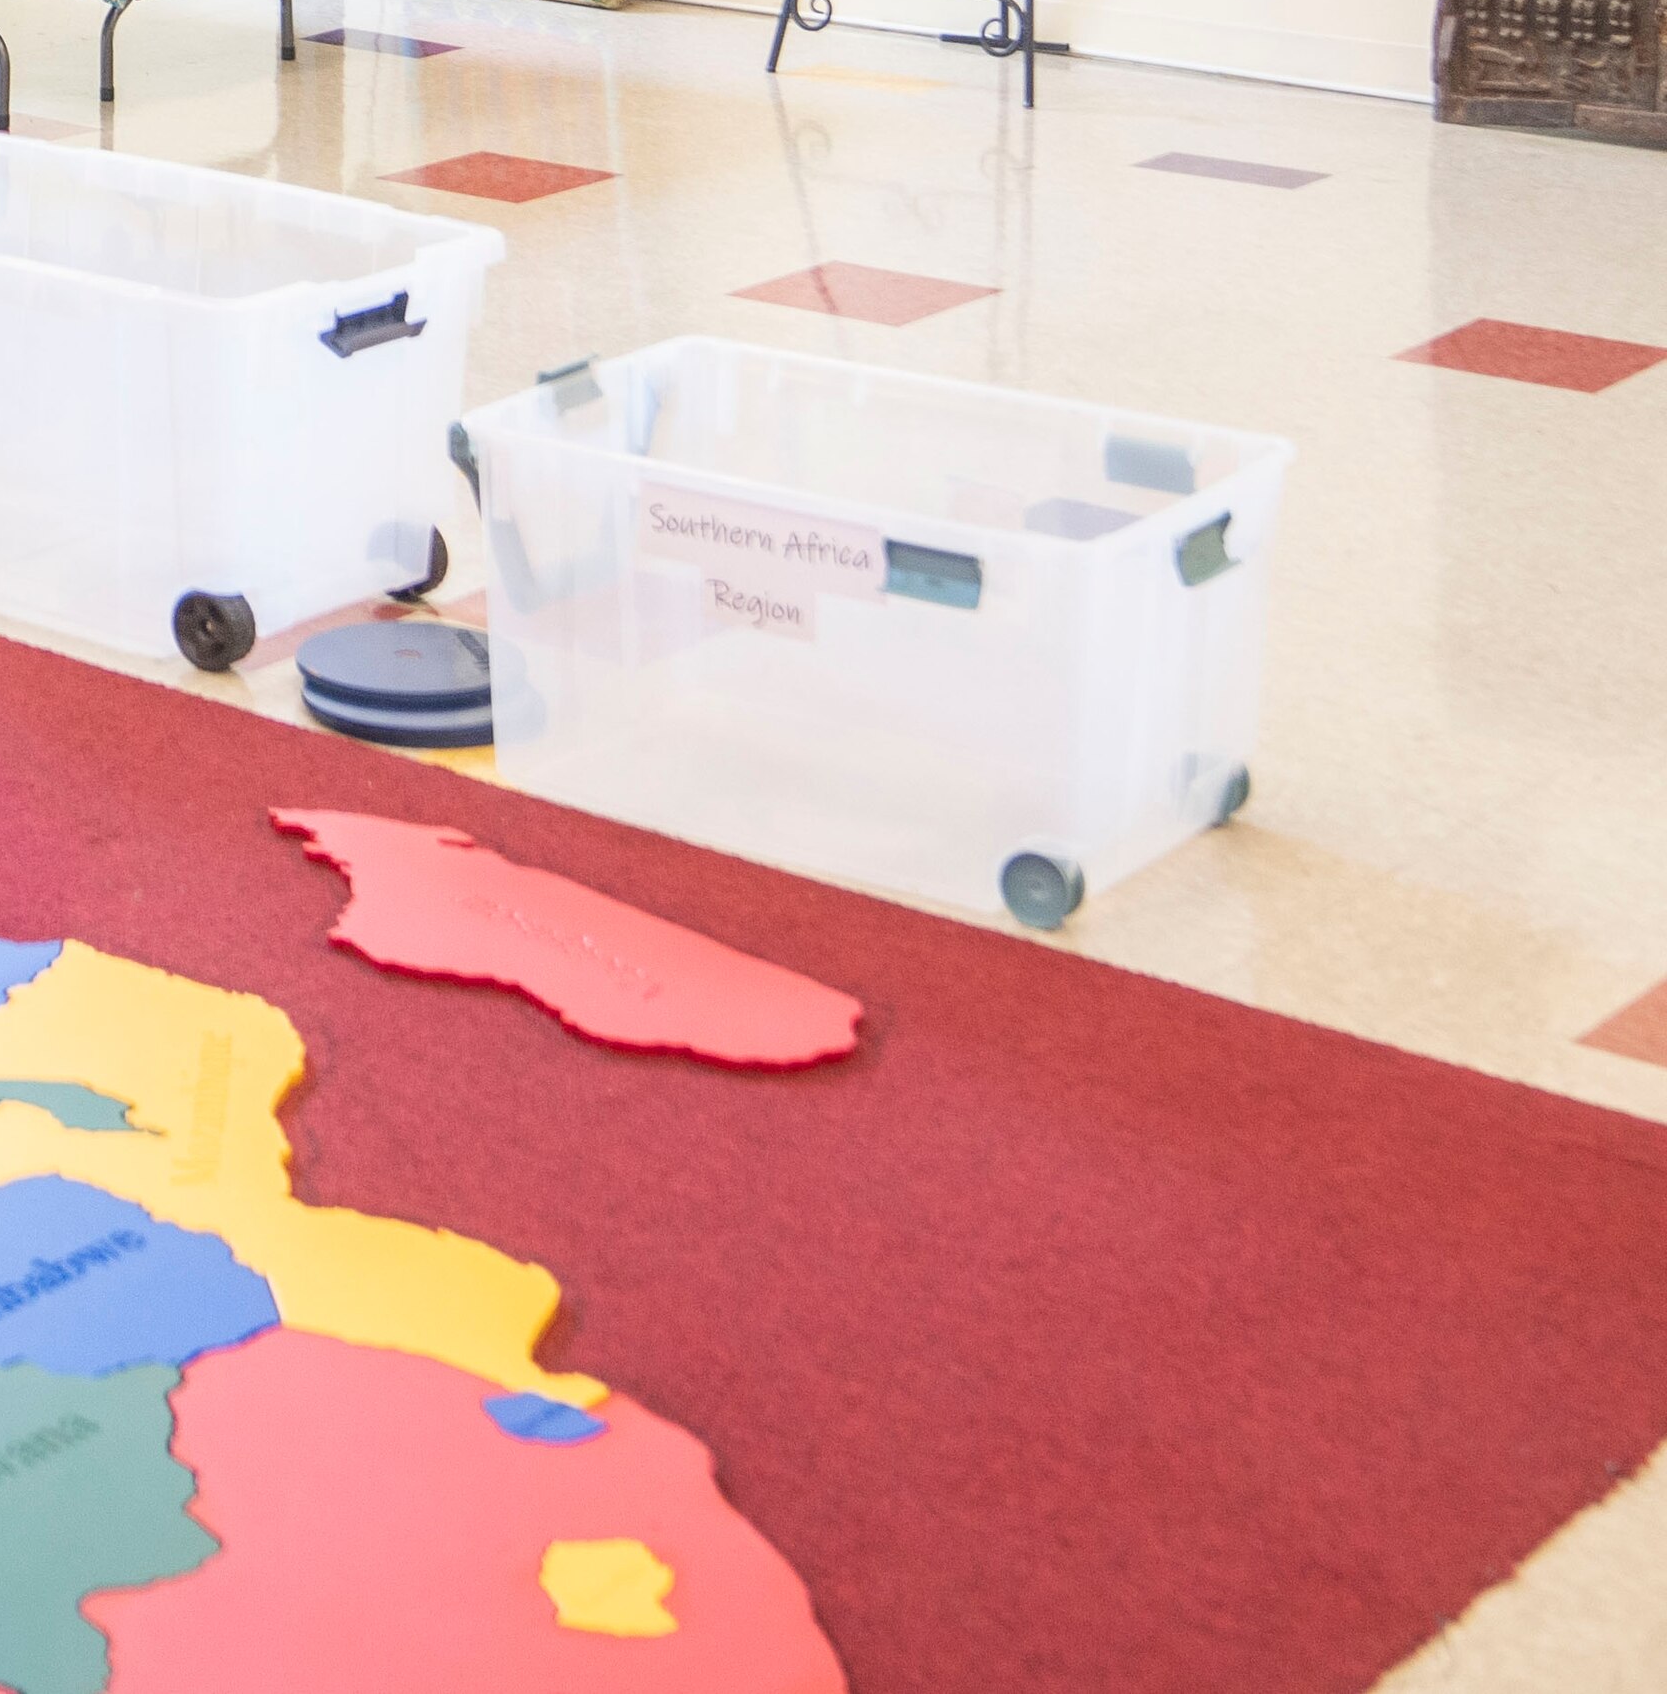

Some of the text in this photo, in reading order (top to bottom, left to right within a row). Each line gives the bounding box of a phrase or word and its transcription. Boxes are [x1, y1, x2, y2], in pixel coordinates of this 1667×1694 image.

[649, 503, 871, 571] Southern Africa
[704, 578, 801, 626] Region
